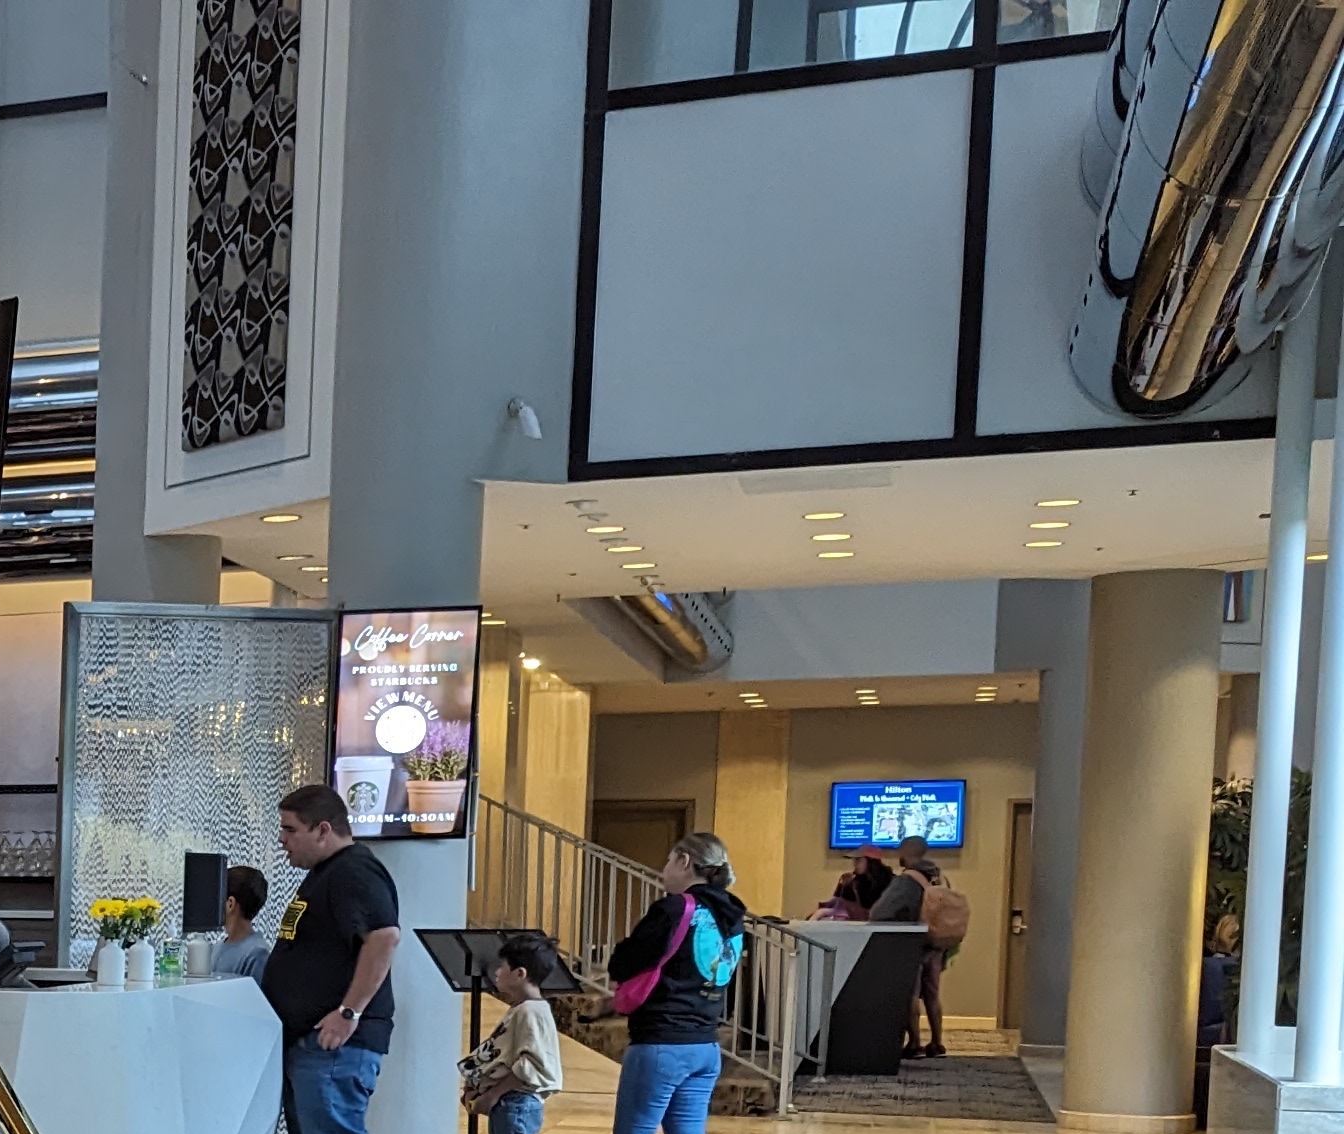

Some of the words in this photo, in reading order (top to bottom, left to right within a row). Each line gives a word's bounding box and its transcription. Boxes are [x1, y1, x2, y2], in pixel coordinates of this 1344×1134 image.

[354, 625, 409, 652] Coffee
[409, 623, 464, 648] Corner
[352, 664, 405, 674] PROUDLY
[409, 663, 458, 672] SERVING
[370, 677, 438, 686] STARBUCKS
[363, 691, 400, 721] VIEW
[401, 690, 440, 721] MENU
[885, 785, 912, 794] Hilton
